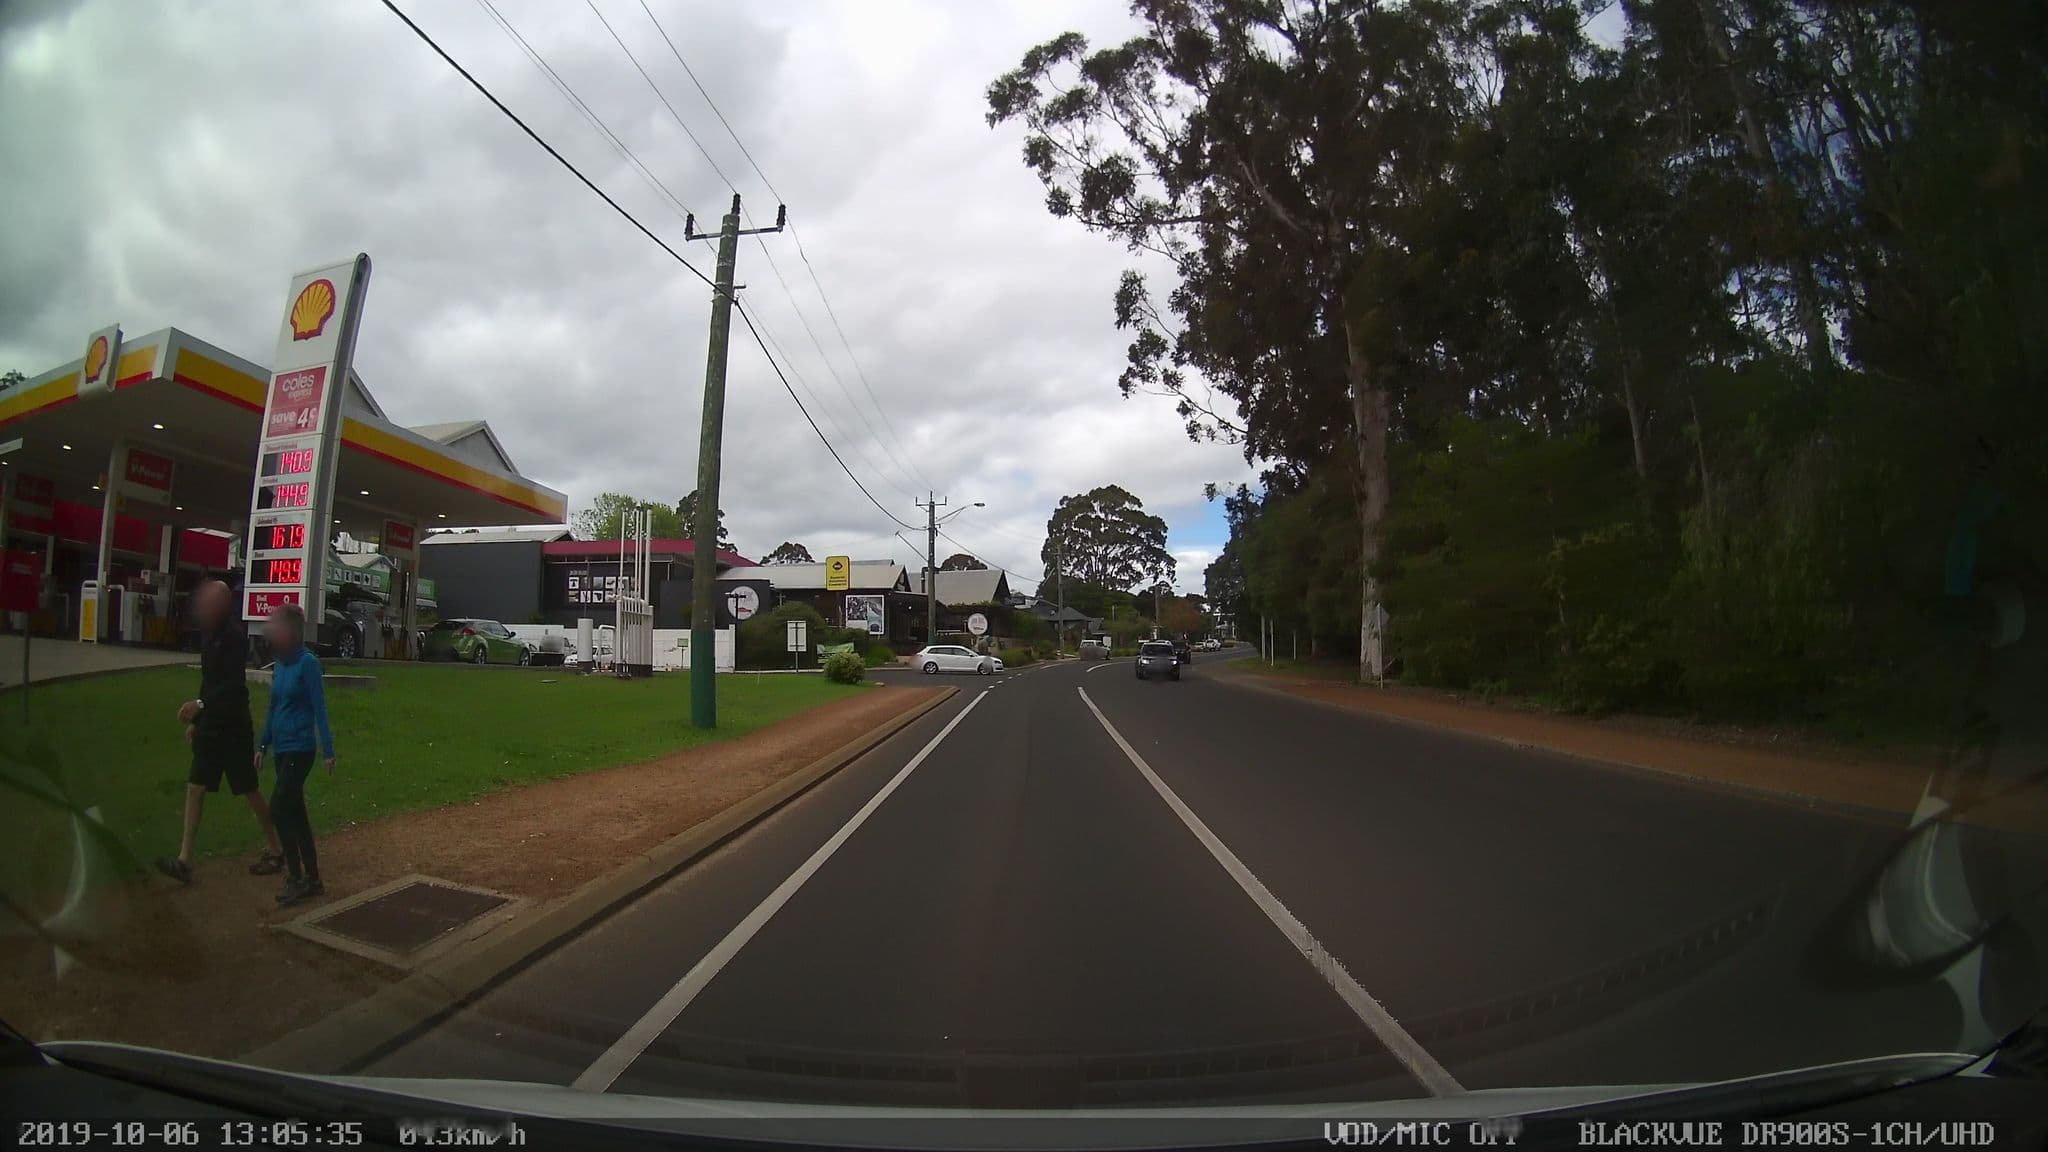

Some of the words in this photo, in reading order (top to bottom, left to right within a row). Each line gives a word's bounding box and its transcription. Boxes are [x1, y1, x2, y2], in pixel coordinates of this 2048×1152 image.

[283, 374, 314, 391] coles
[271, 411, 296, 425] save
[280, 447, 314, 475] 140.9
[276, 483, 308, 508] 144.9
[271, 525, 304, 549] 161.9
[269, 559, 302, 583] 149.9
